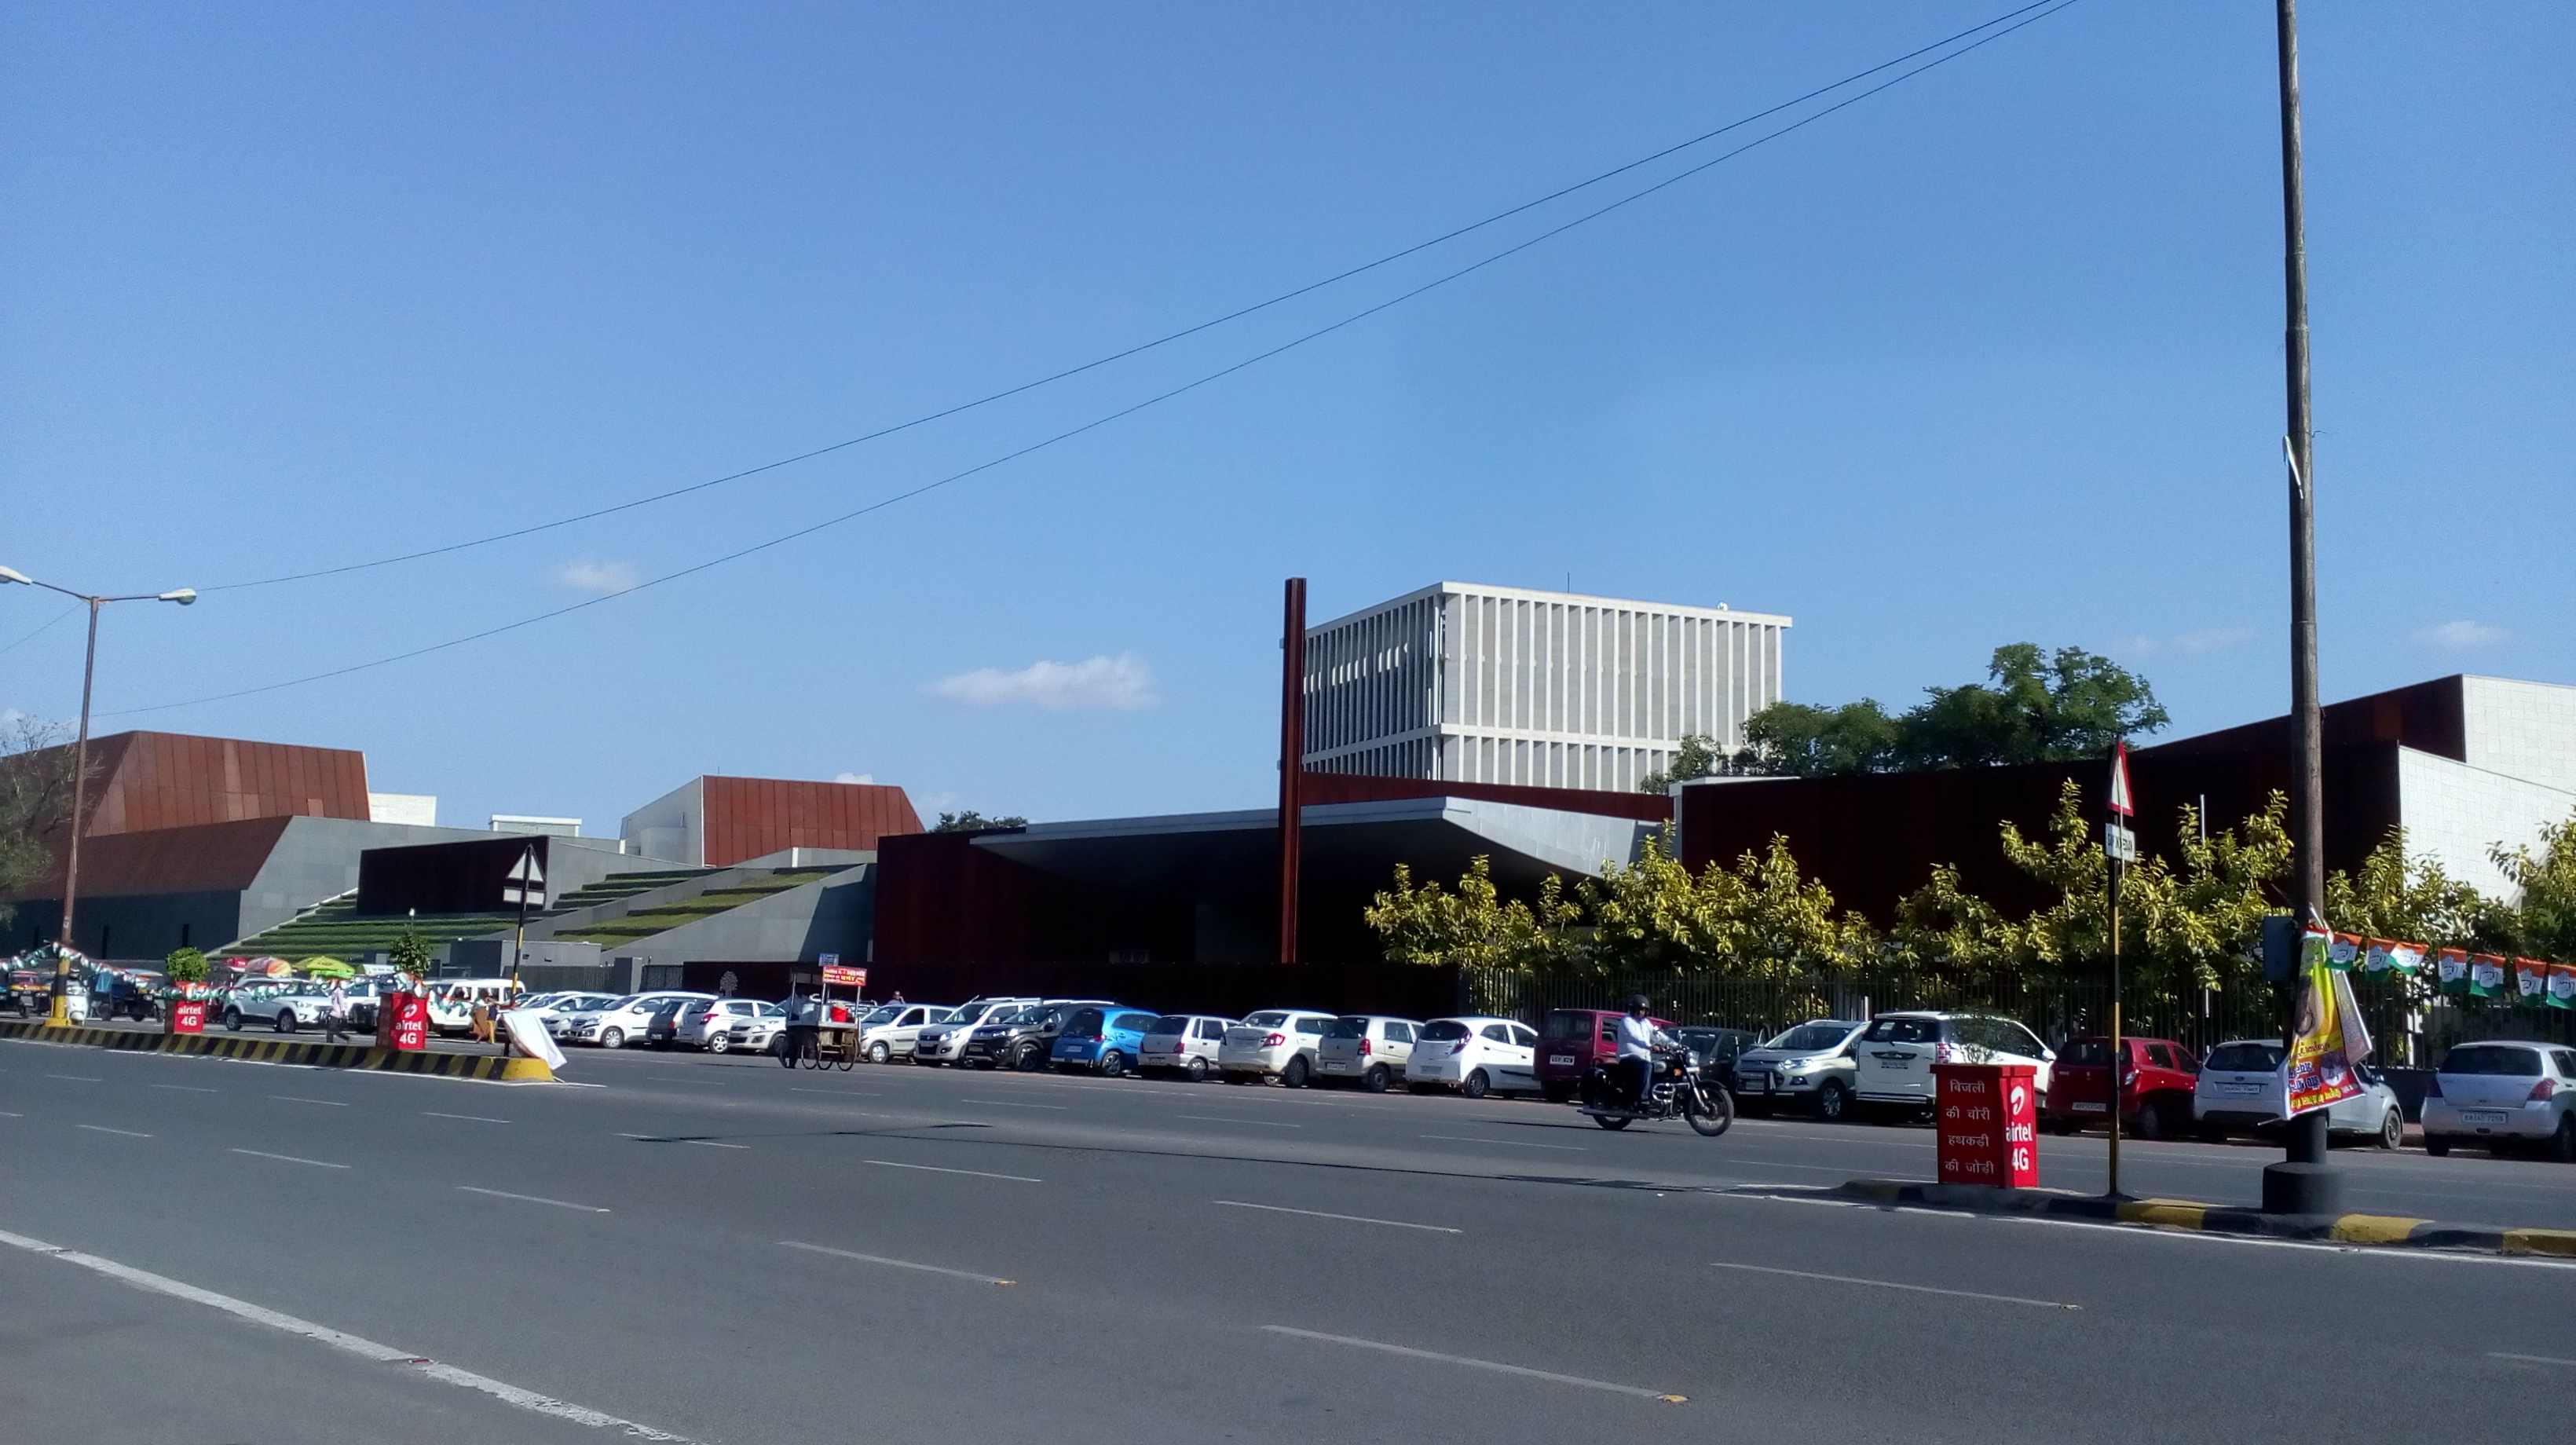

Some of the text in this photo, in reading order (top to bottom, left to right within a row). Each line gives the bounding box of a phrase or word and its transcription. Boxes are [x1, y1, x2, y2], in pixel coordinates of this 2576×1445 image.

[177, 1005, 202, 1015] airtel
[181, 1015, 197, 1026] 4G
[395, 1019, 423, 1030] airtel
[399, 1032, 417, 1044] 4G
[1950, 1079, 1985, 1093] बिजली
[1945, 1106, 1990, 1121] की चोरी
[2006, 1121, 2033, 1142] airtel
[1948, 1133, 1989, 1149] हथकड़ी
[2011, 1147, 2029, 1171] 4G
[1945, 1158, 1994, 1176] की जोड़ी
